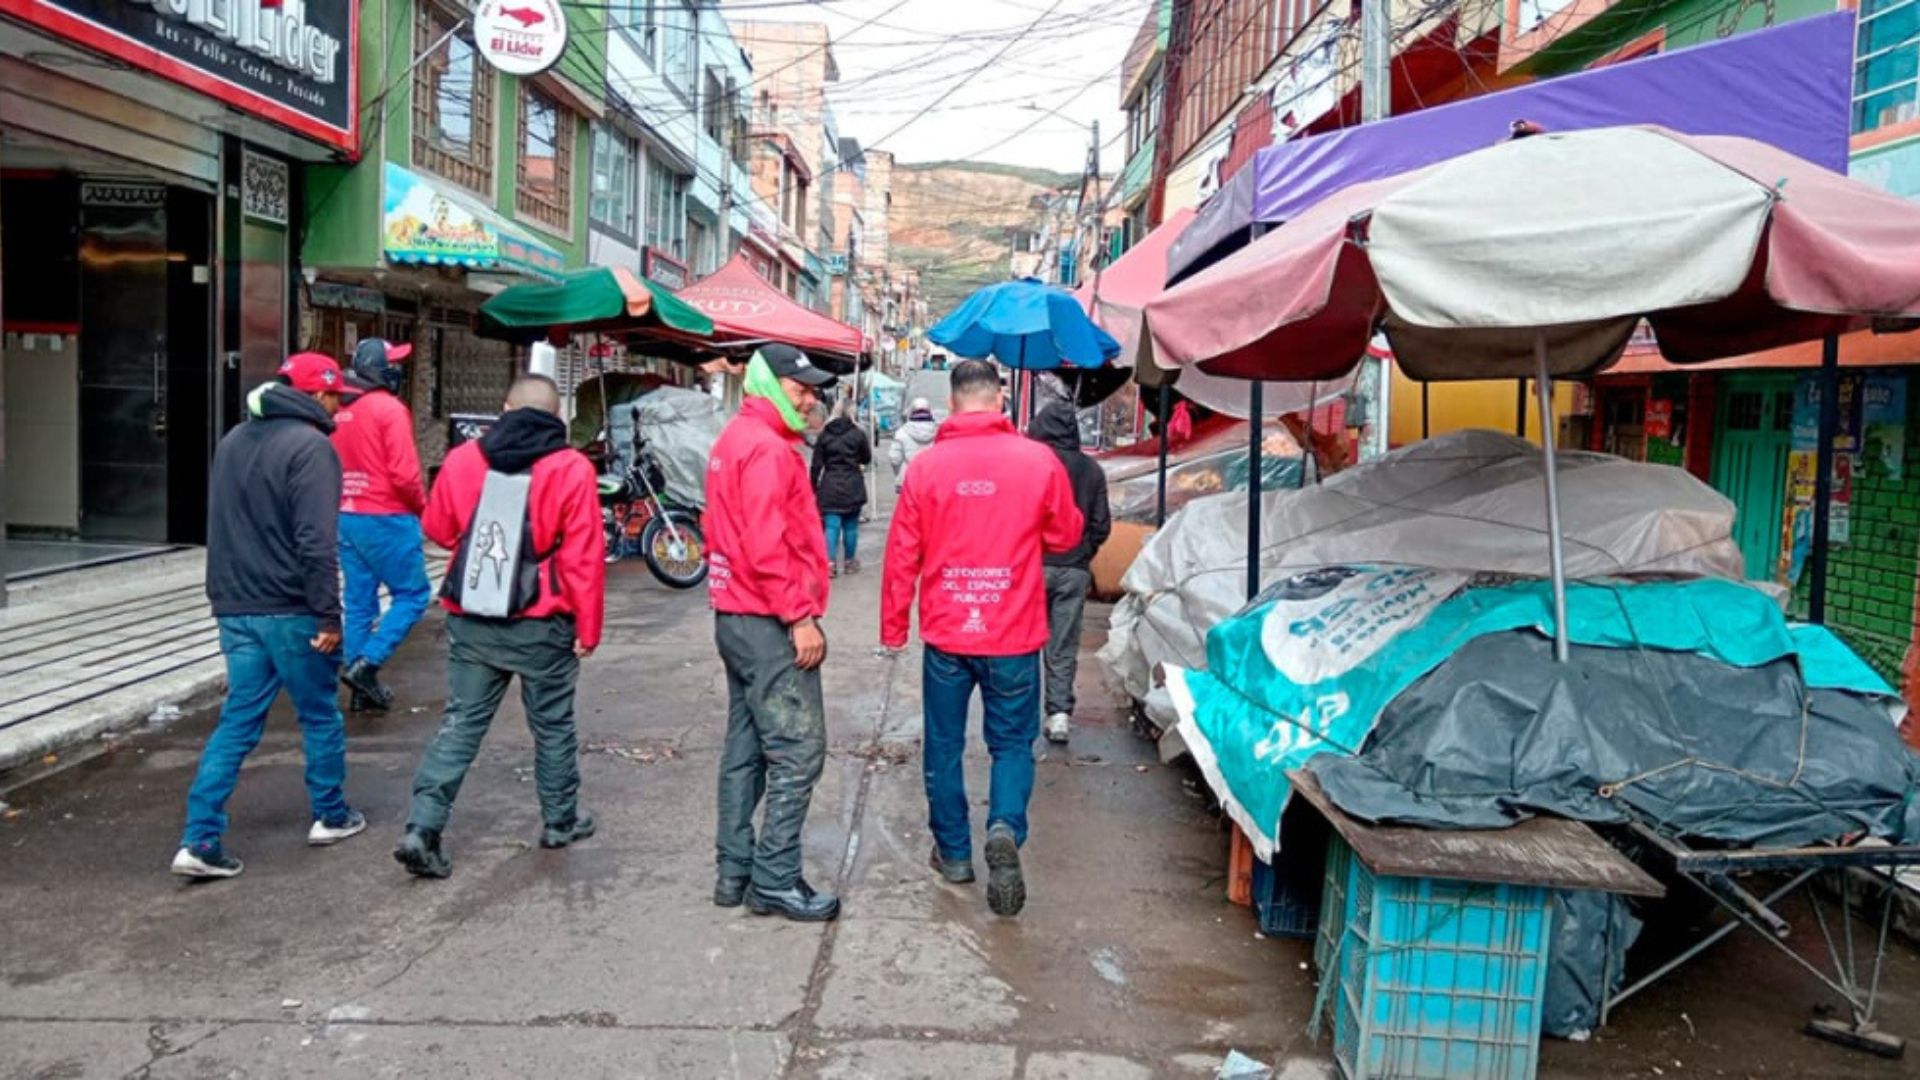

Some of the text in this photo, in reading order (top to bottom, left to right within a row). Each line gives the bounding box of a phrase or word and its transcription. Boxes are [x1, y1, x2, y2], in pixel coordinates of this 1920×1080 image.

[490, 37, 504, 51] El
[155, 18, 326, 107] Res Pollo Cerdo Pescado
[943, 568, 1011, 577] DEFENSORES
[942, 580, 1010, 590] DEL ESPACIO
